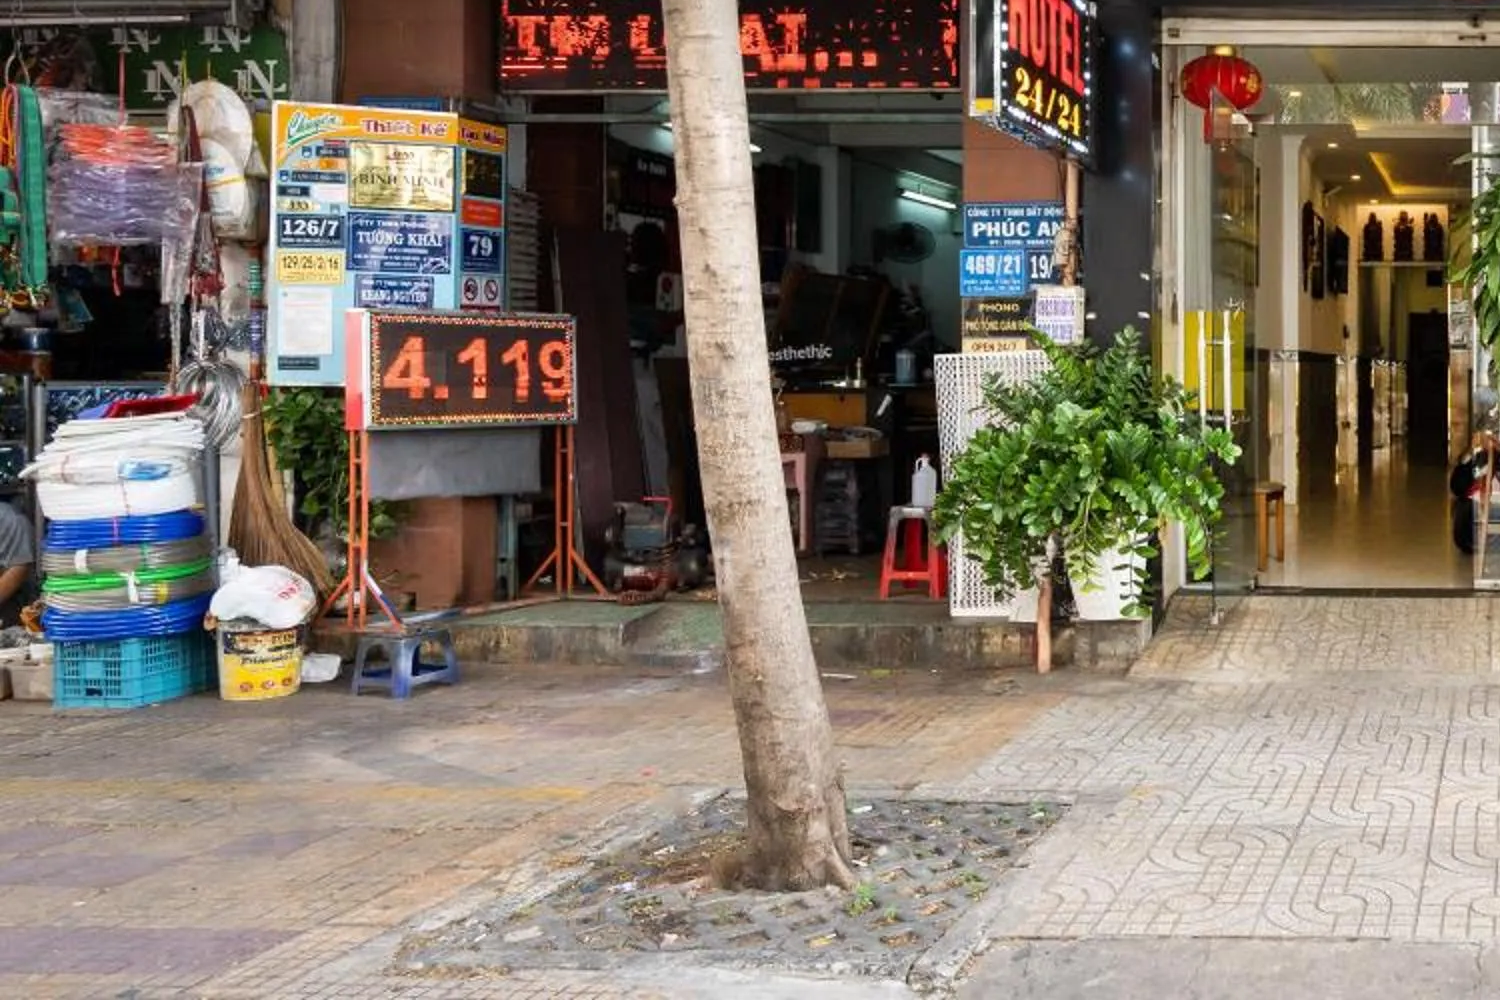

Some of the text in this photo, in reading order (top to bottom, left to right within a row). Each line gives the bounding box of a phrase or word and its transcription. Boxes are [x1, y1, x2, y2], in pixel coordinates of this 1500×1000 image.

[1015, 66, 1080, 137] 24/24
[283, 218, 340, 237] 126/7
[972, 217, 1031, 237] PHÚC
[469, 235, 493, 257] 79
[965, 254, 1021, 275] 469/21
[382, 335, 572, 402] 4.119
